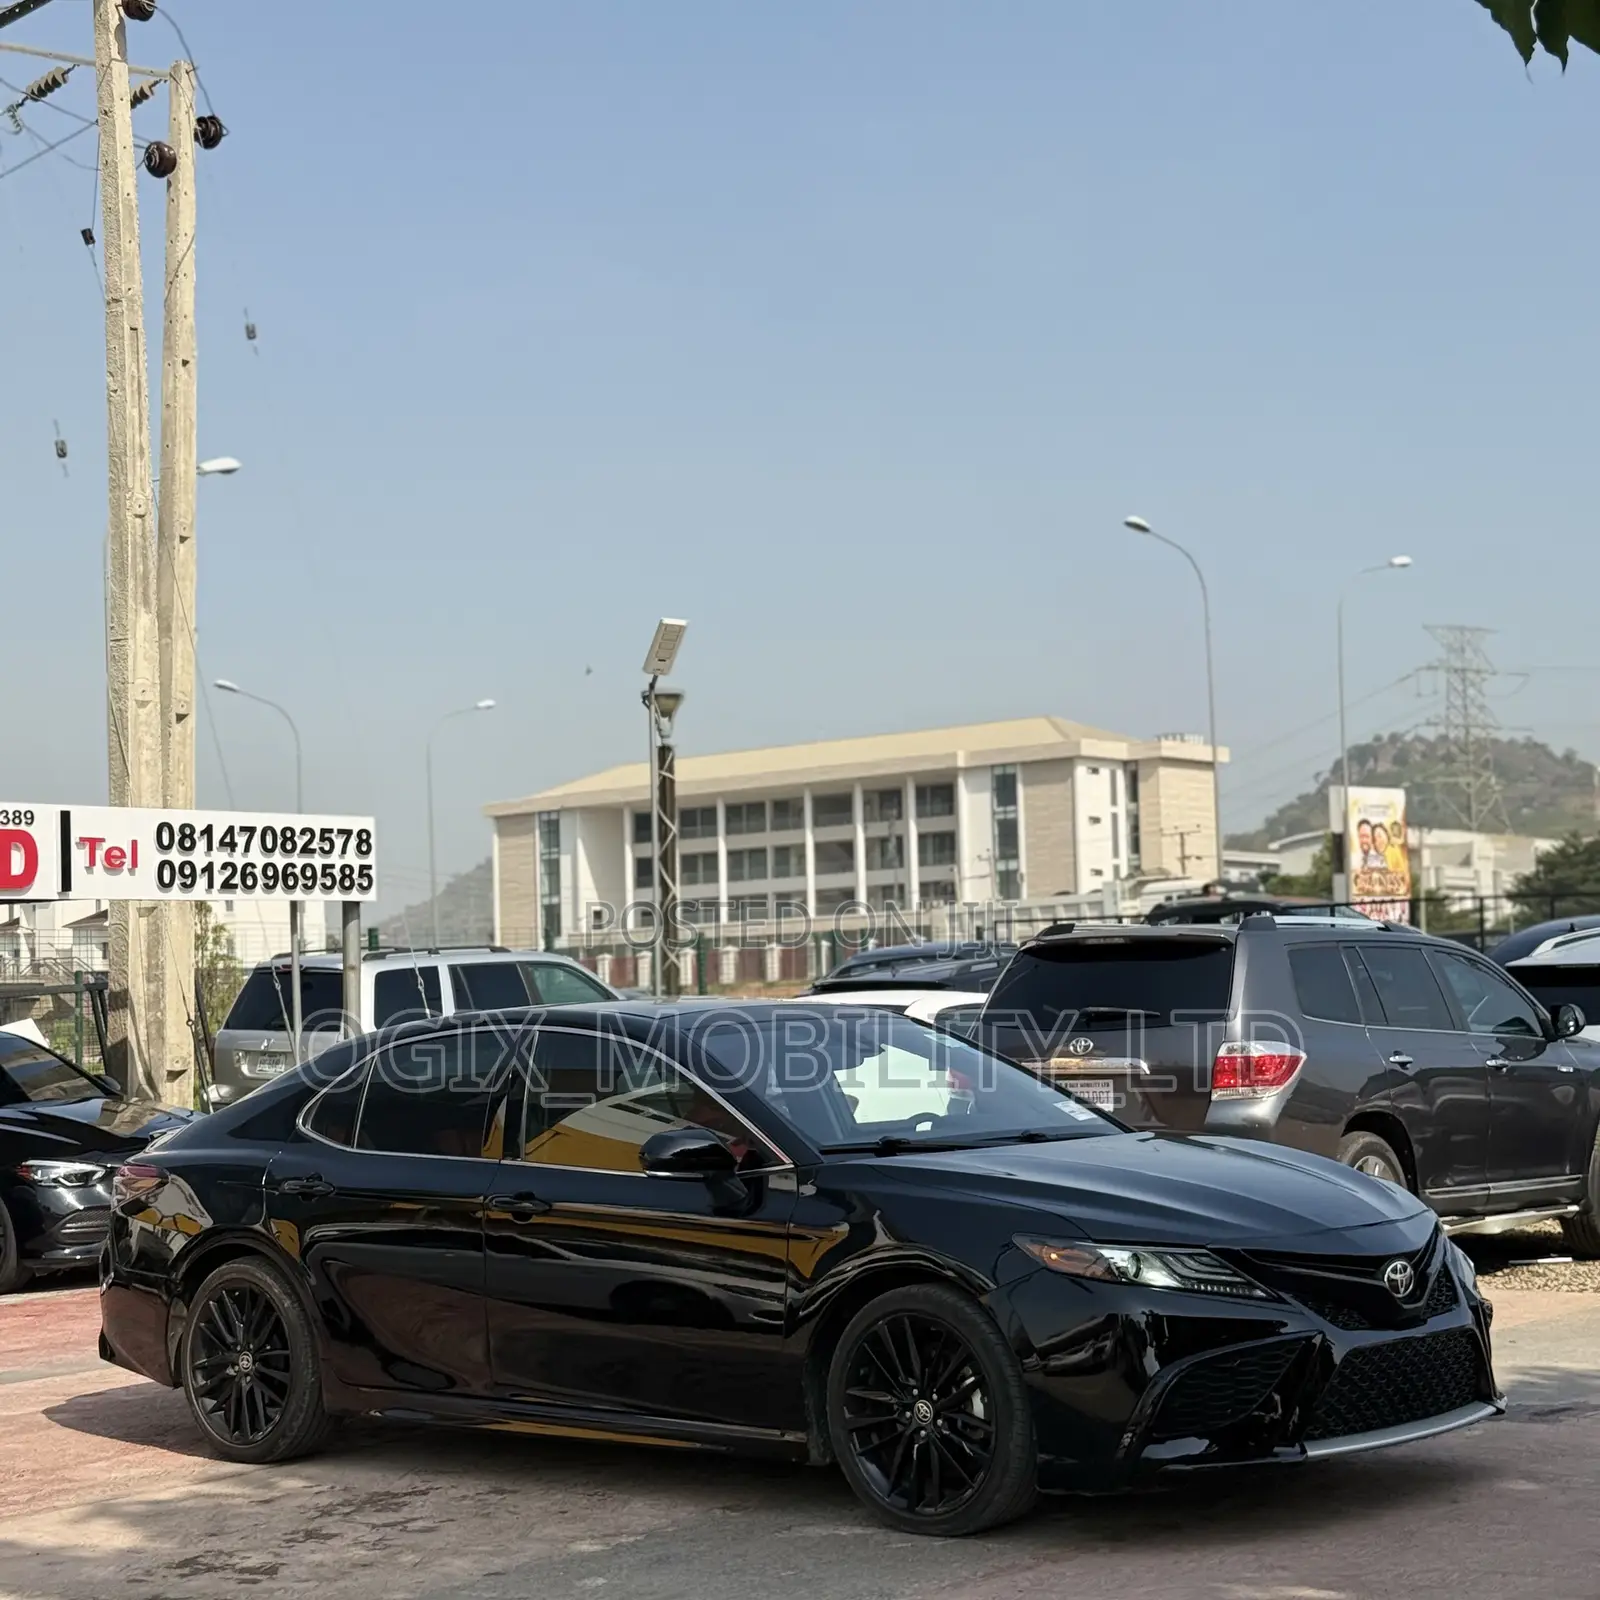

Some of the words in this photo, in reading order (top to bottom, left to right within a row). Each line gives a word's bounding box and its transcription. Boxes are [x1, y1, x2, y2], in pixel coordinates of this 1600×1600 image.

[77, 836, 138, 870] Tel
[155, 821, 373, 856] 08147082578
[0, 828, 39, 890] D
[156, 859, 374, 892] 09126969585
